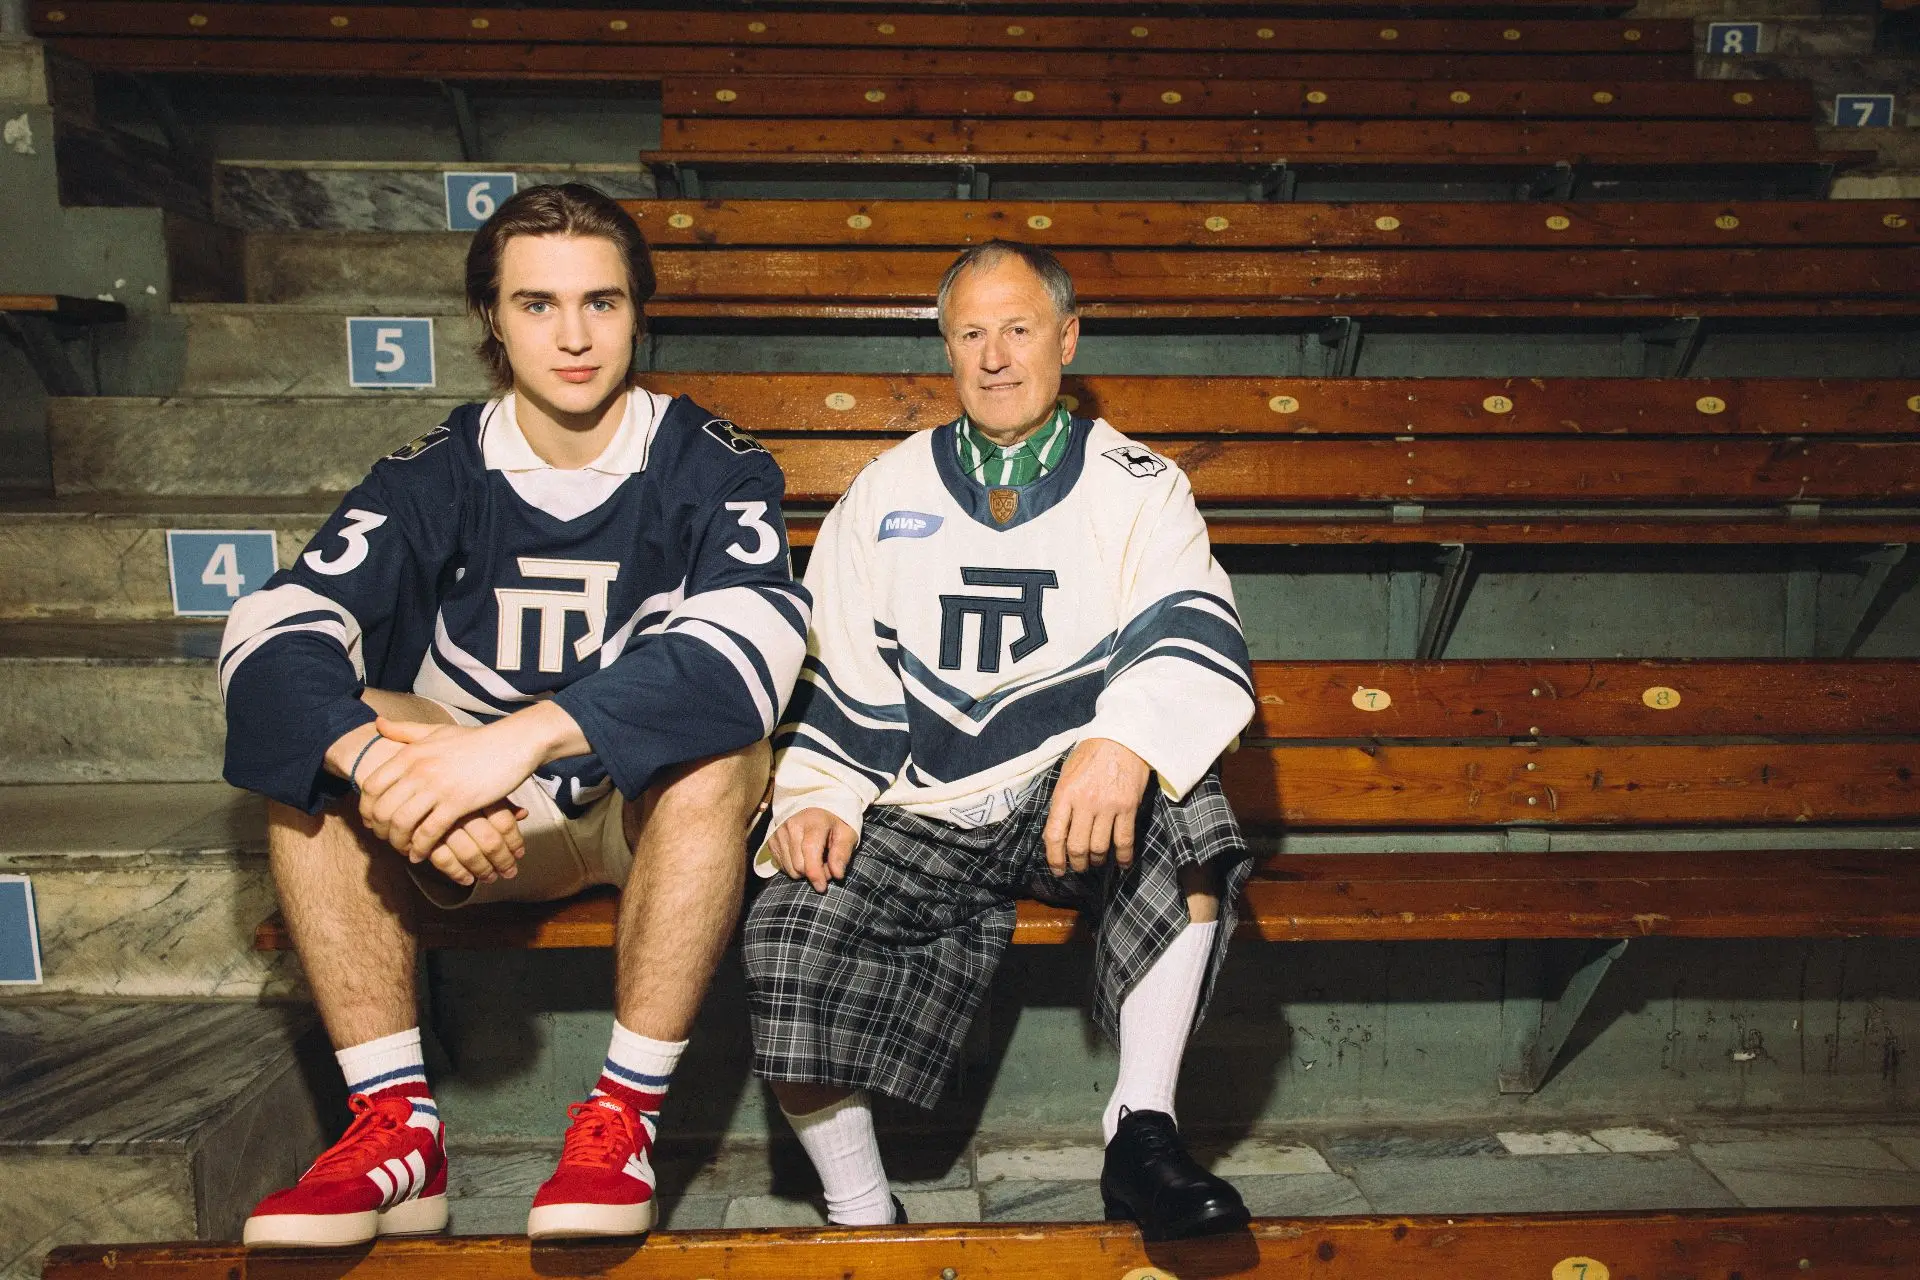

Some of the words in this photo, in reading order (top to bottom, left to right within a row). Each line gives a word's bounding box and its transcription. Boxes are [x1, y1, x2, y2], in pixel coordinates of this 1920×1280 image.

[1723, 30, 1742, 53] 8
[1853, 102, 1873, 126] 7
[467, 182, 495, 220] 6
[1035, 217, 1044, 227] 6
[375, 328, 405, 372] 5
[1278, 399, 1291, 411] 7
[1494, 399, 1505, 410] 8
[885, 517, 927, 531] МИР
[725, 500, 781, 565] 3
[303, 508, 387, 576] 3
[202, 544, 245, 596] 4
[1365, 693, 1378, 708] 7
[1656, 692, 1669, 706] 8
[598, 1101, 622, 1112] adidas
[1572, 1264, 1588, 1280] 7
